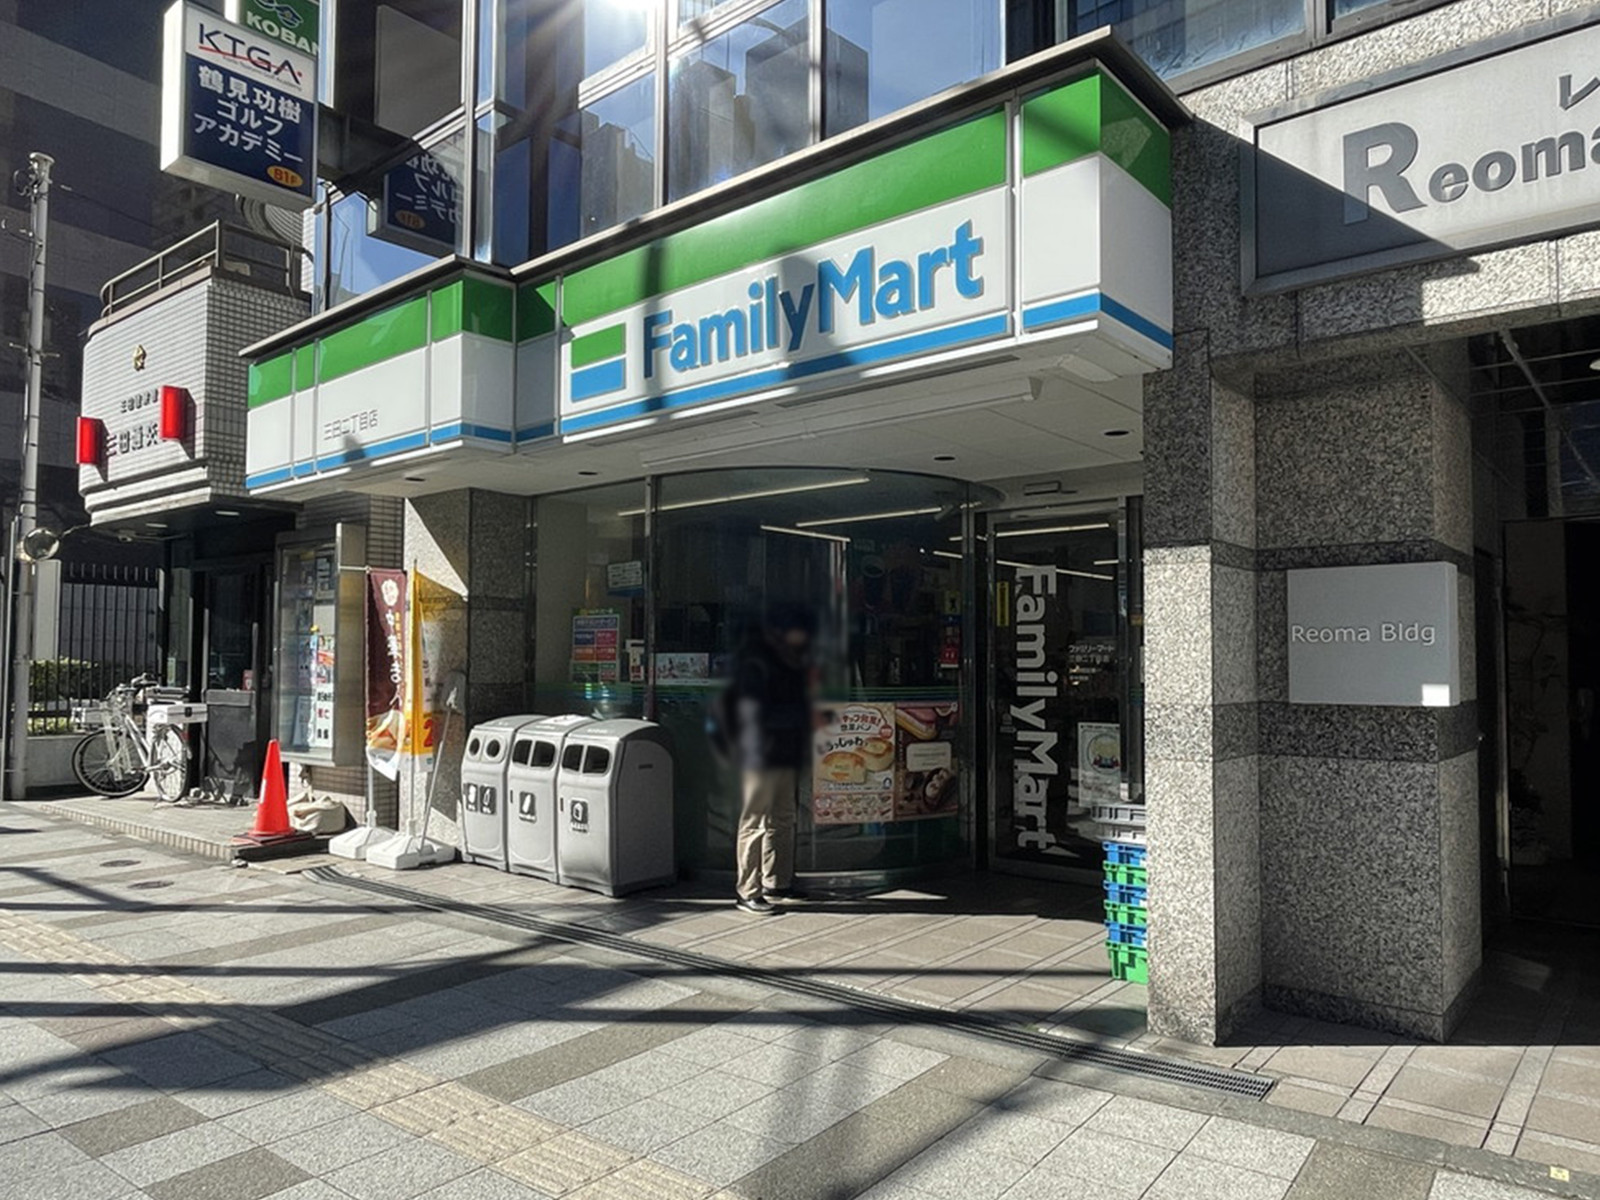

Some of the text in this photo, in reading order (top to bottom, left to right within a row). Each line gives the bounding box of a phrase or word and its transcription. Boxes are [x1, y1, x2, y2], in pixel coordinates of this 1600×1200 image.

[199, 23, 302, 85] KTGA
[198, 65, 301, 125] 鶴見功樹
[216, 99, 284, 137] ゴルフ
[193, 112, 303, 163] アカデミー
[1342, 121, 1600, 226] Reom
[643, 218, 985, 378] FamilyMart
[323, 409, 379, 441] 三田二丁目店
[1291, 622, 1436, 646] Reoma Bldg
[1010, 564, 1059, 851] FamilyMart
